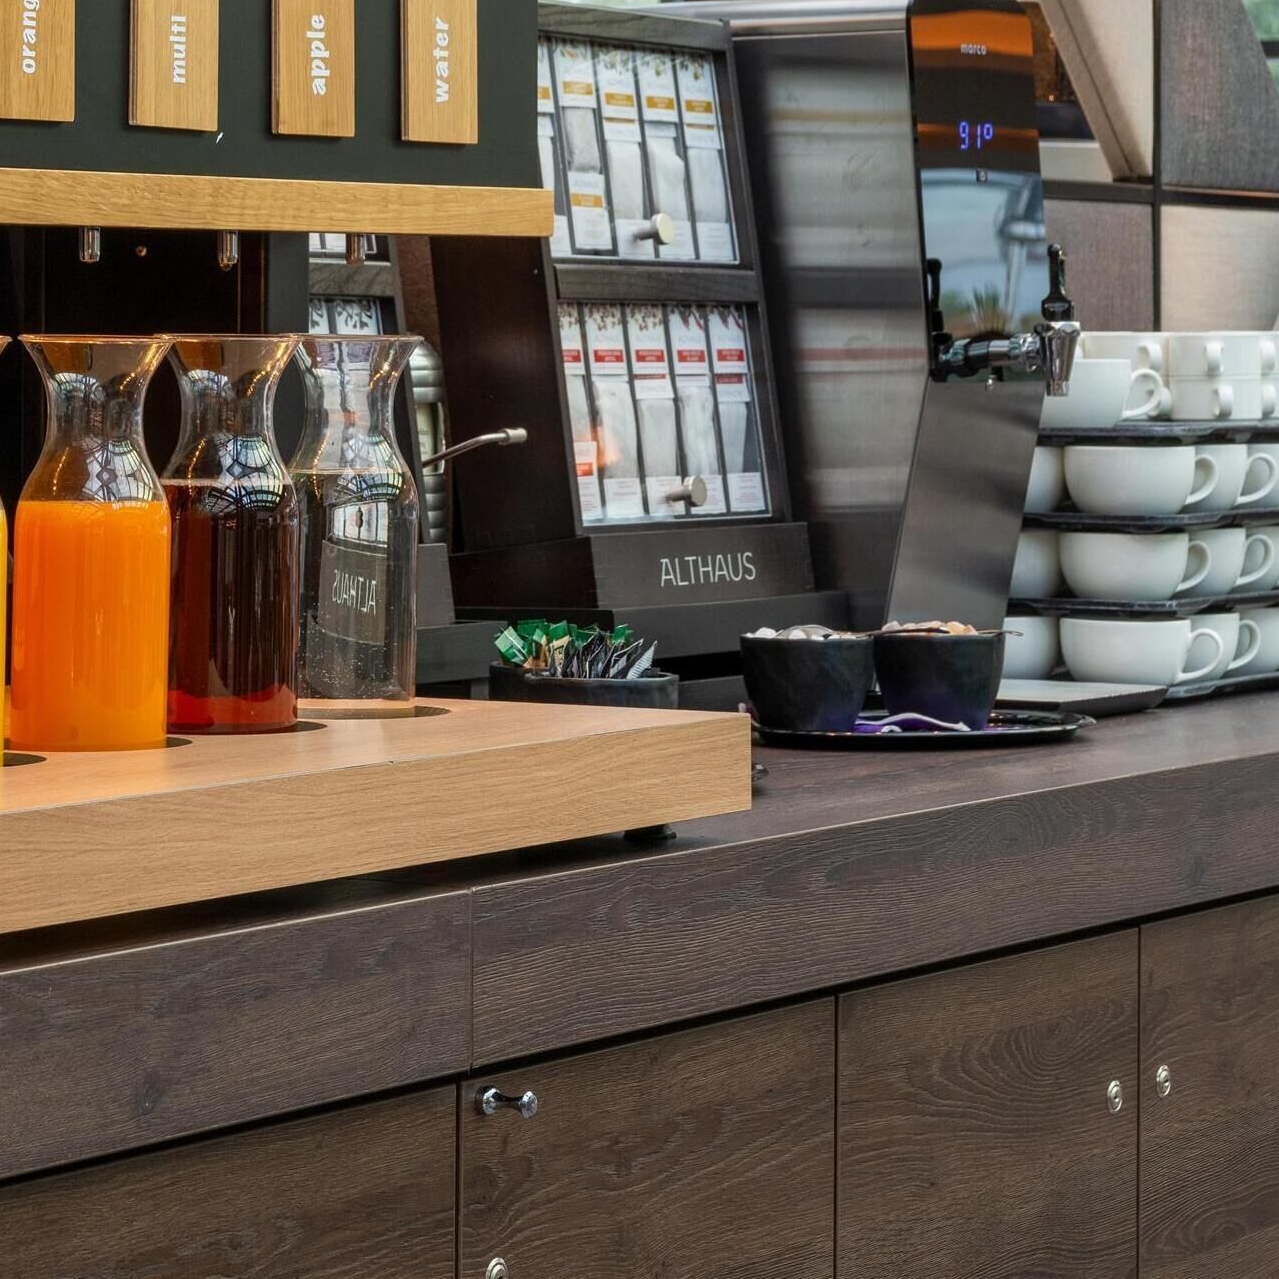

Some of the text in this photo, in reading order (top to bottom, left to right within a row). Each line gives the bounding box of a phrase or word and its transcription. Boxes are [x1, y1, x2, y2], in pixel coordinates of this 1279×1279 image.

[168, 14, 188, 84] multi
[305, 14, 329, 96] apple
[432, 16, 451, 104] water
[960, 43, 987, 55] marco
[660, 551, 757, 587] ALTHAUS
